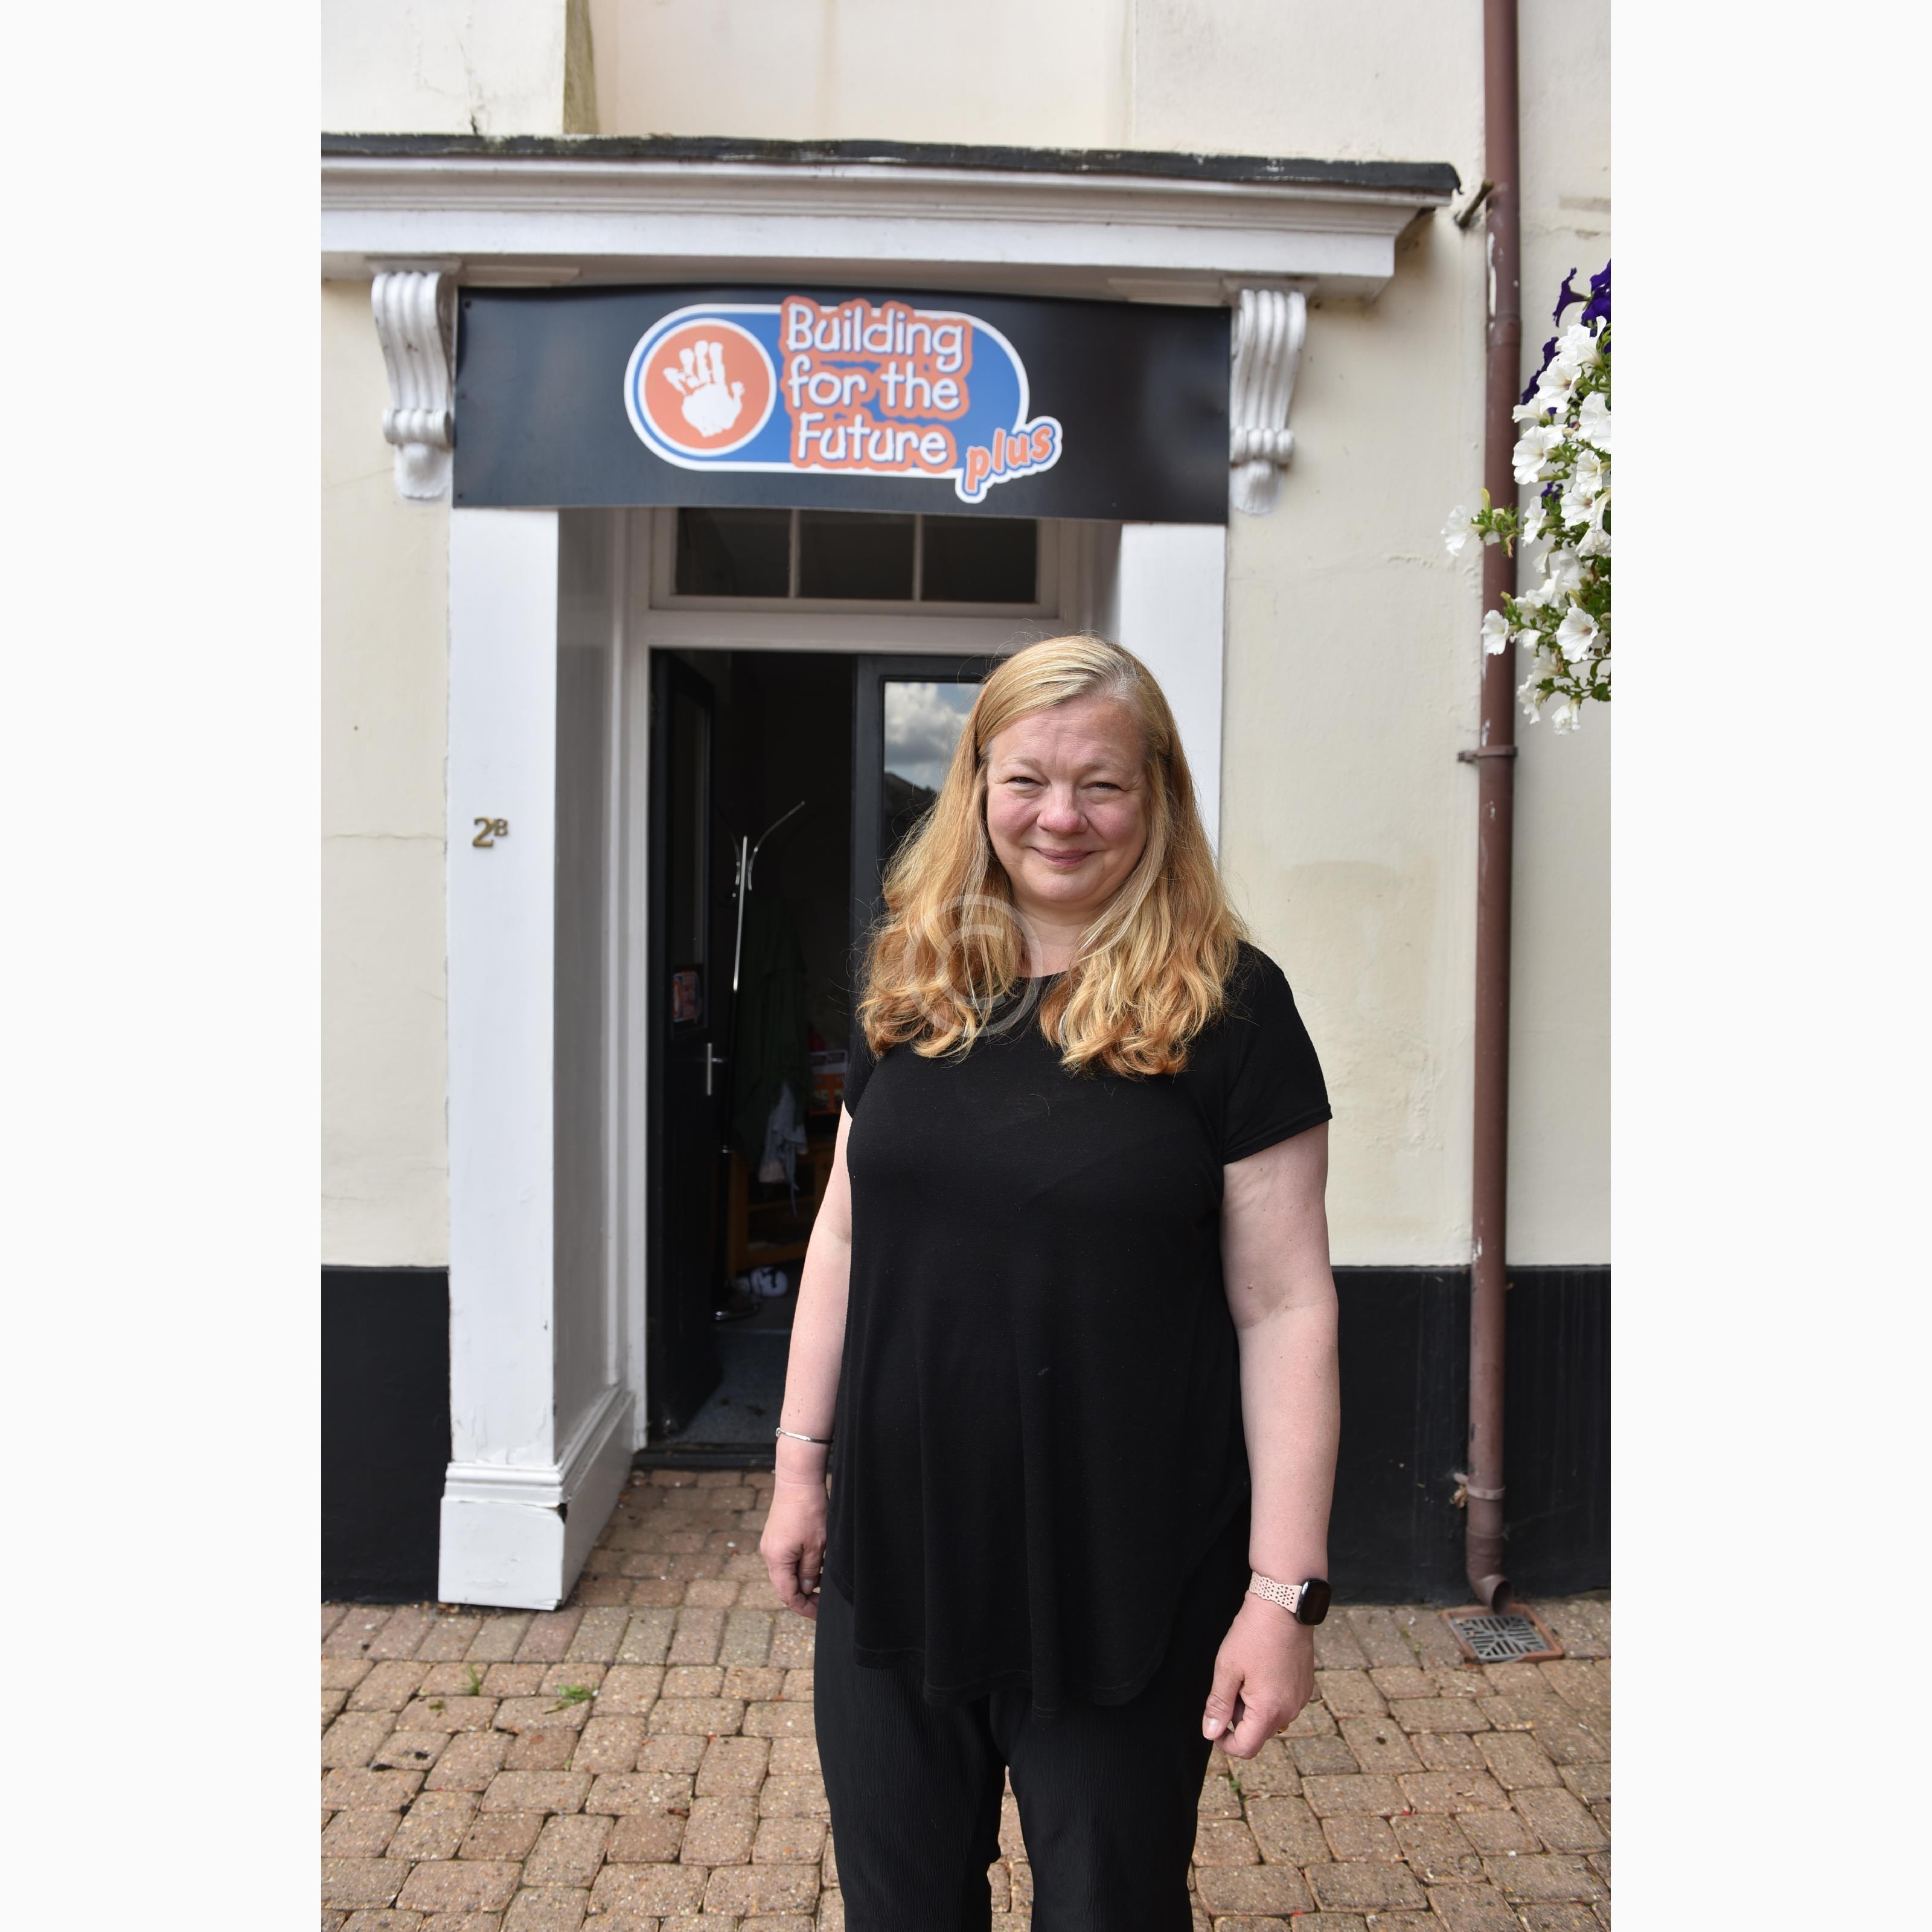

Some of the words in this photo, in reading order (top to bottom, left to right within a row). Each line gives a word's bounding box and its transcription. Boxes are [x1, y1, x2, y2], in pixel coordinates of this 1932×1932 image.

[785, 302, 964, 374] Building
[787, 353, 868, 409] for
[879, 360, 961, 412] the
[797, 411, 948, 465] Future
[965, 425, 1054, 493] plus
